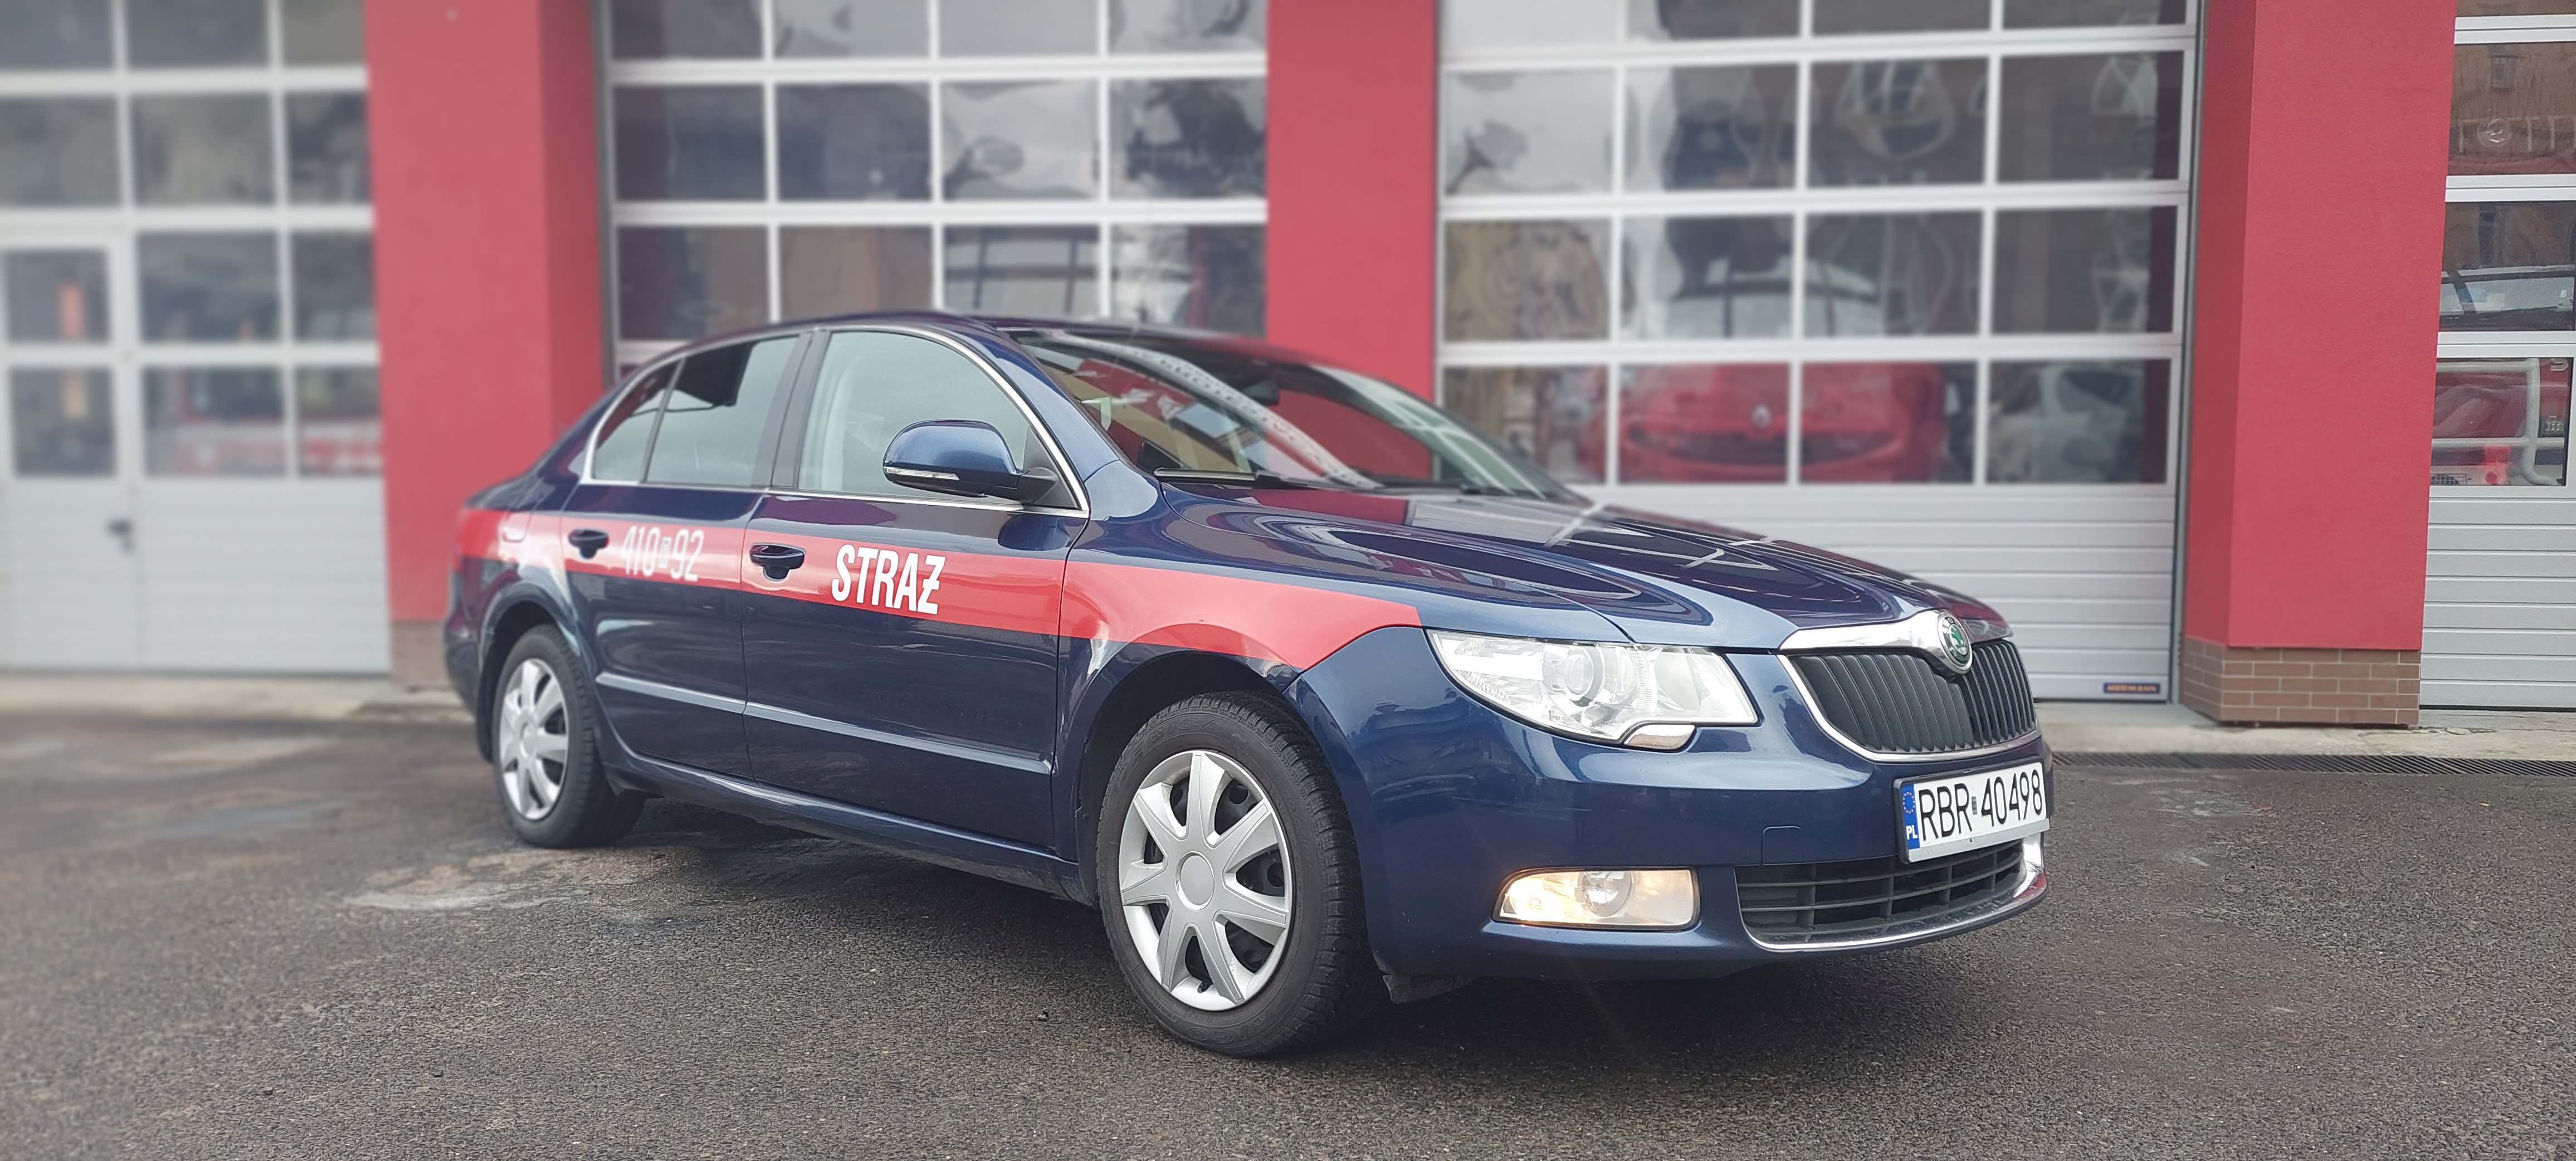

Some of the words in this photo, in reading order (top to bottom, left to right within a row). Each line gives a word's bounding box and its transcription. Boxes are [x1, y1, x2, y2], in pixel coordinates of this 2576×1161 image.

[1918, 783, 1973, 841] RBR
[1981, 769, 2043, 827] 40498
[1906, 825, 1918, 840] PL
